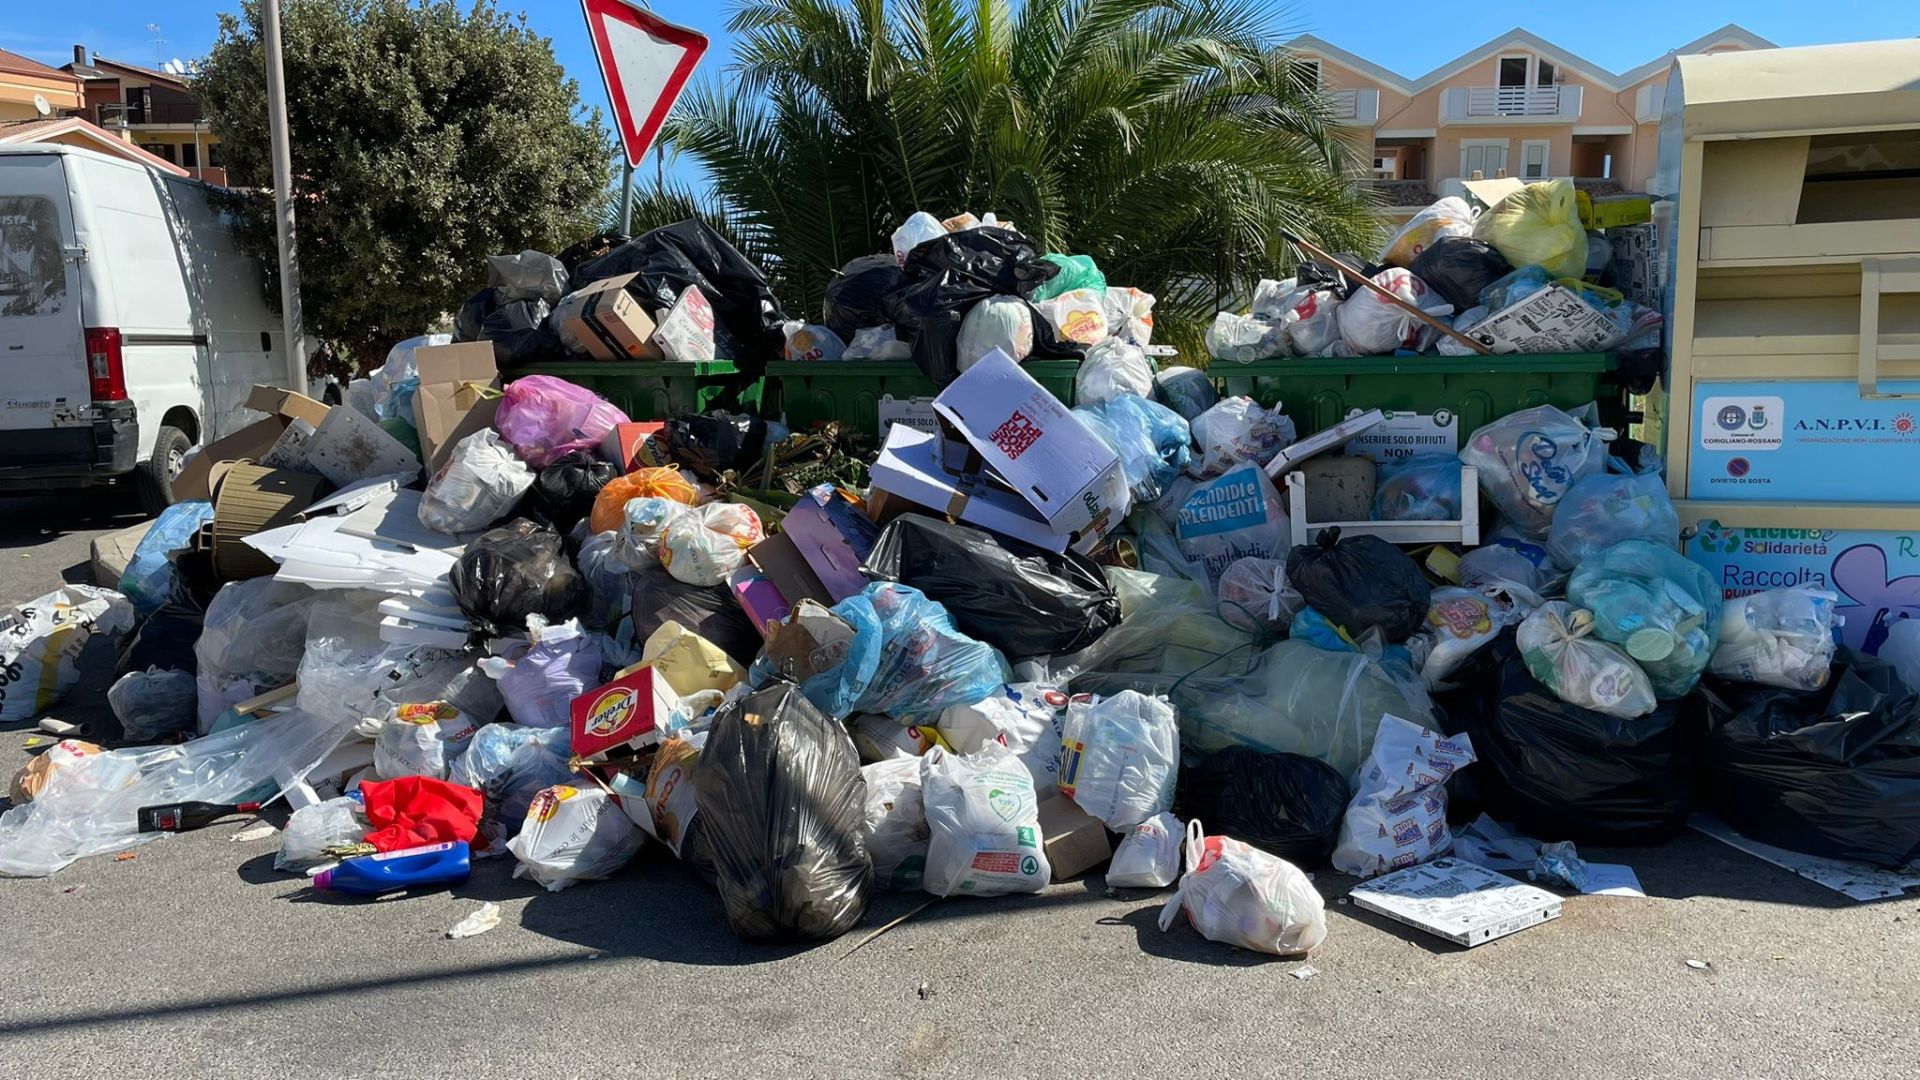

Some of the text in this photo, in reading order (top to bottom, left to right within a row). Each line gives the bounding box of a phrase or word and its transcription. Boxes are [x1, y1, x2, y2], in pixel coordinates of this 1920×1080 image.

[1393, 435, 1414, 445] SOLO
[1416, 435, 1447, 445] RIFIUTI
[1384, 448, 1414, 458] NON
[1743, 540, 1828, 556] Solidarietà
[1723, 564, 1825, 588] Raccolta
[591, 695, 633, 728] Dreher
